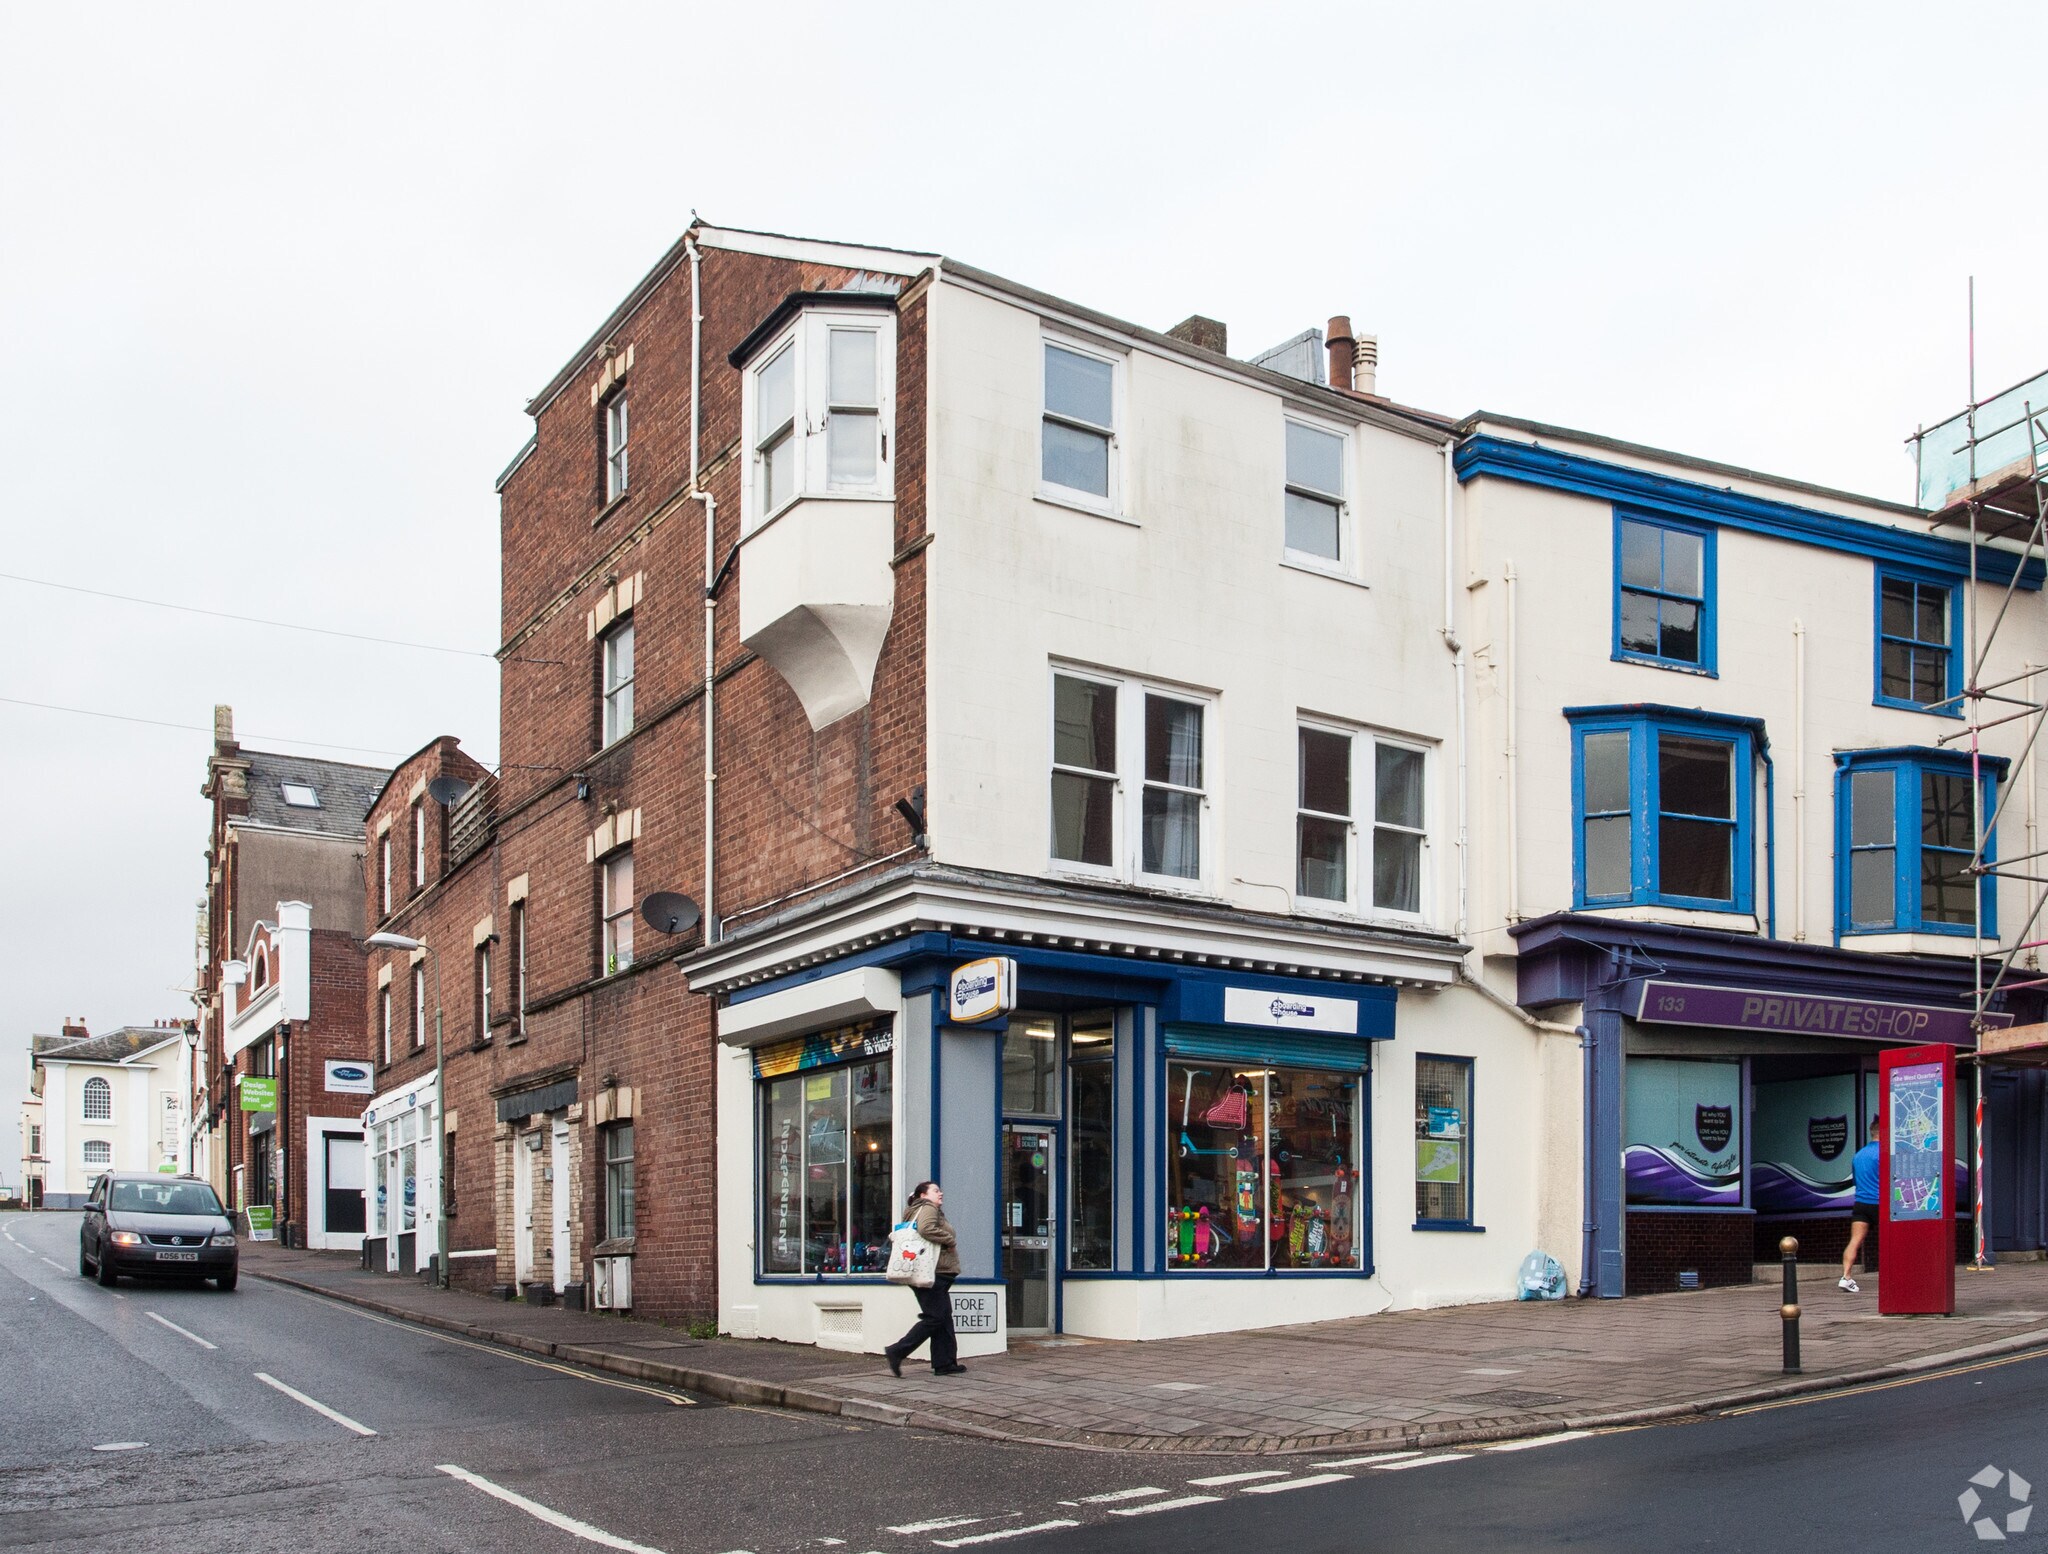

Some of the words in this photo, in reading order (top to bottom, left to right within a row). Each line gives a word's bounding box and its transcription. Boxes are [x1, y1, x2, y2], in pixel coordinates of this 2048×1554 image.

[961, 976, 988, 991] boarding
[962, 990, 980, 1001] house
[1278, 1001, 1307, 1012] boarding
[1658, 996, 1685, 1012] 133
[243, 1081, 267, 1089] Design
[243, 1089, 274, 1097] Websites
[778, 1118, 791, 1254] INDEPENDENT
[954, 1298, 985, 1311] FORE
[952, 1314, 992, 1327] TREET
